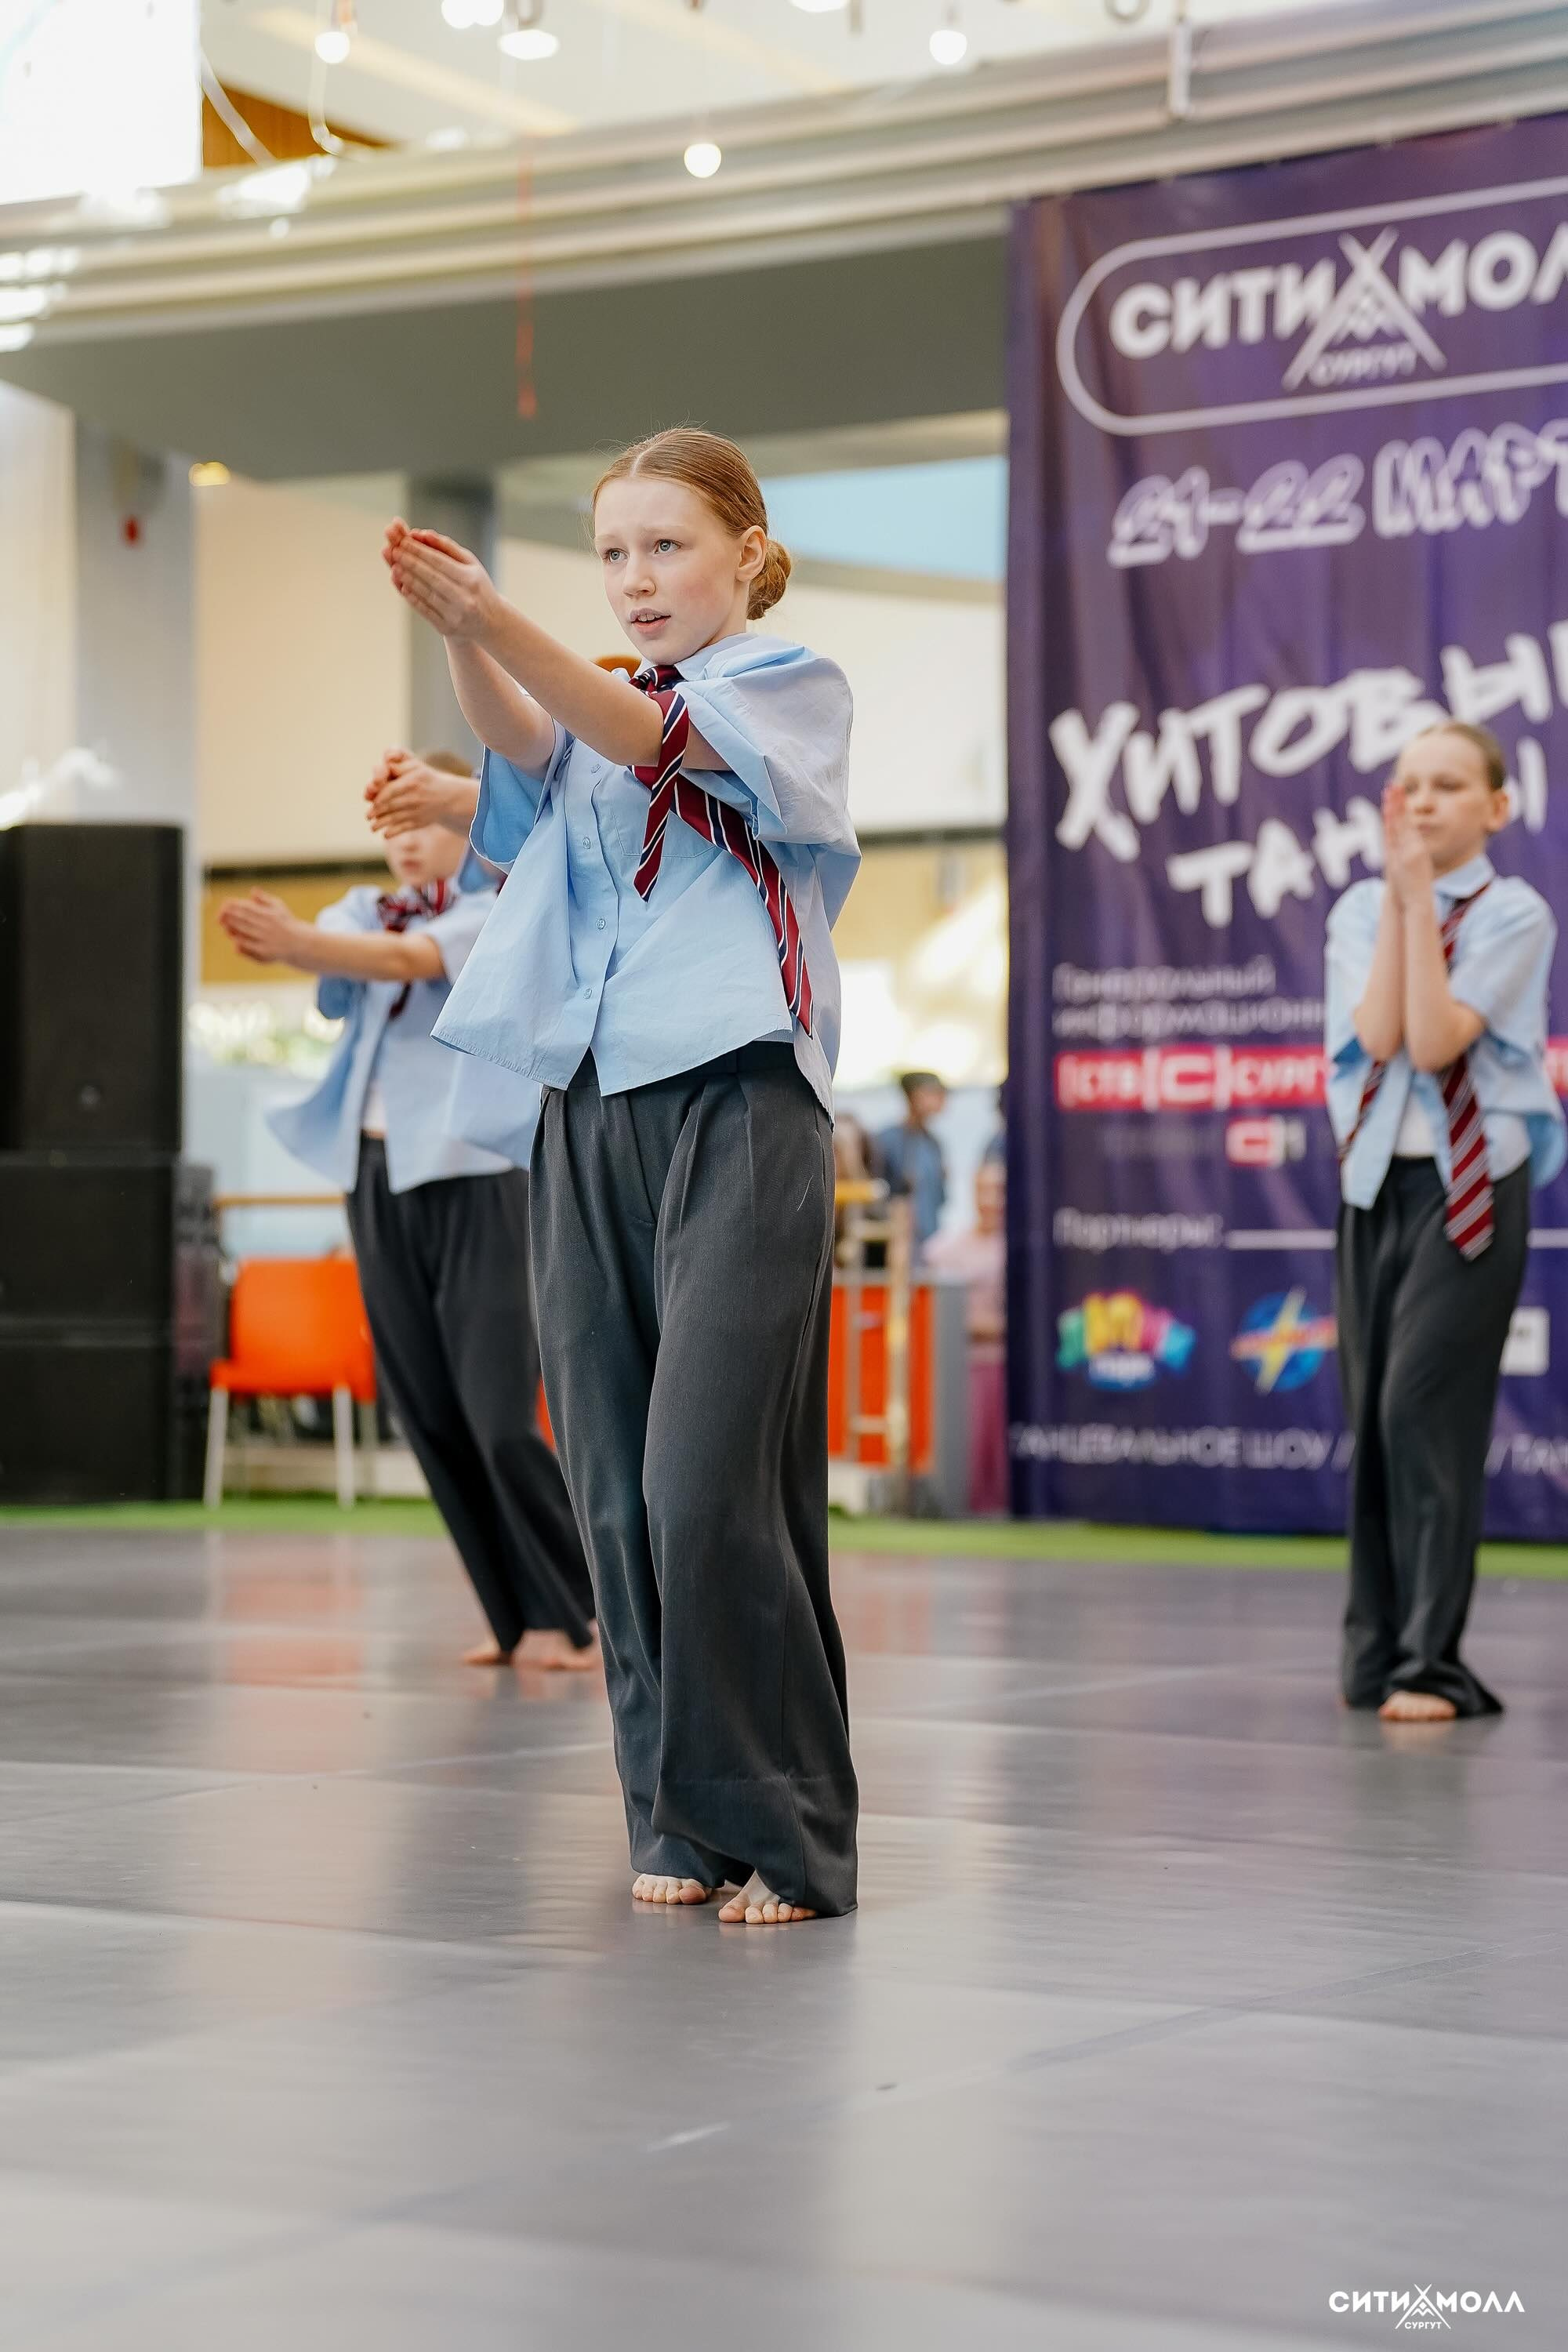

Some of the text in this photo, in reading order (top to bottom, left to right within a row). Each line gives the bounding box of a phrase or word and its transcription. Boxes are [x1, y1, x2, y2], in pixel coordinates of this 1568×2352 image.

[1108, 221, 1568, 361] СИТИ МОЛ
[1049, 619, 1568, 862] ХИТОВЫ
